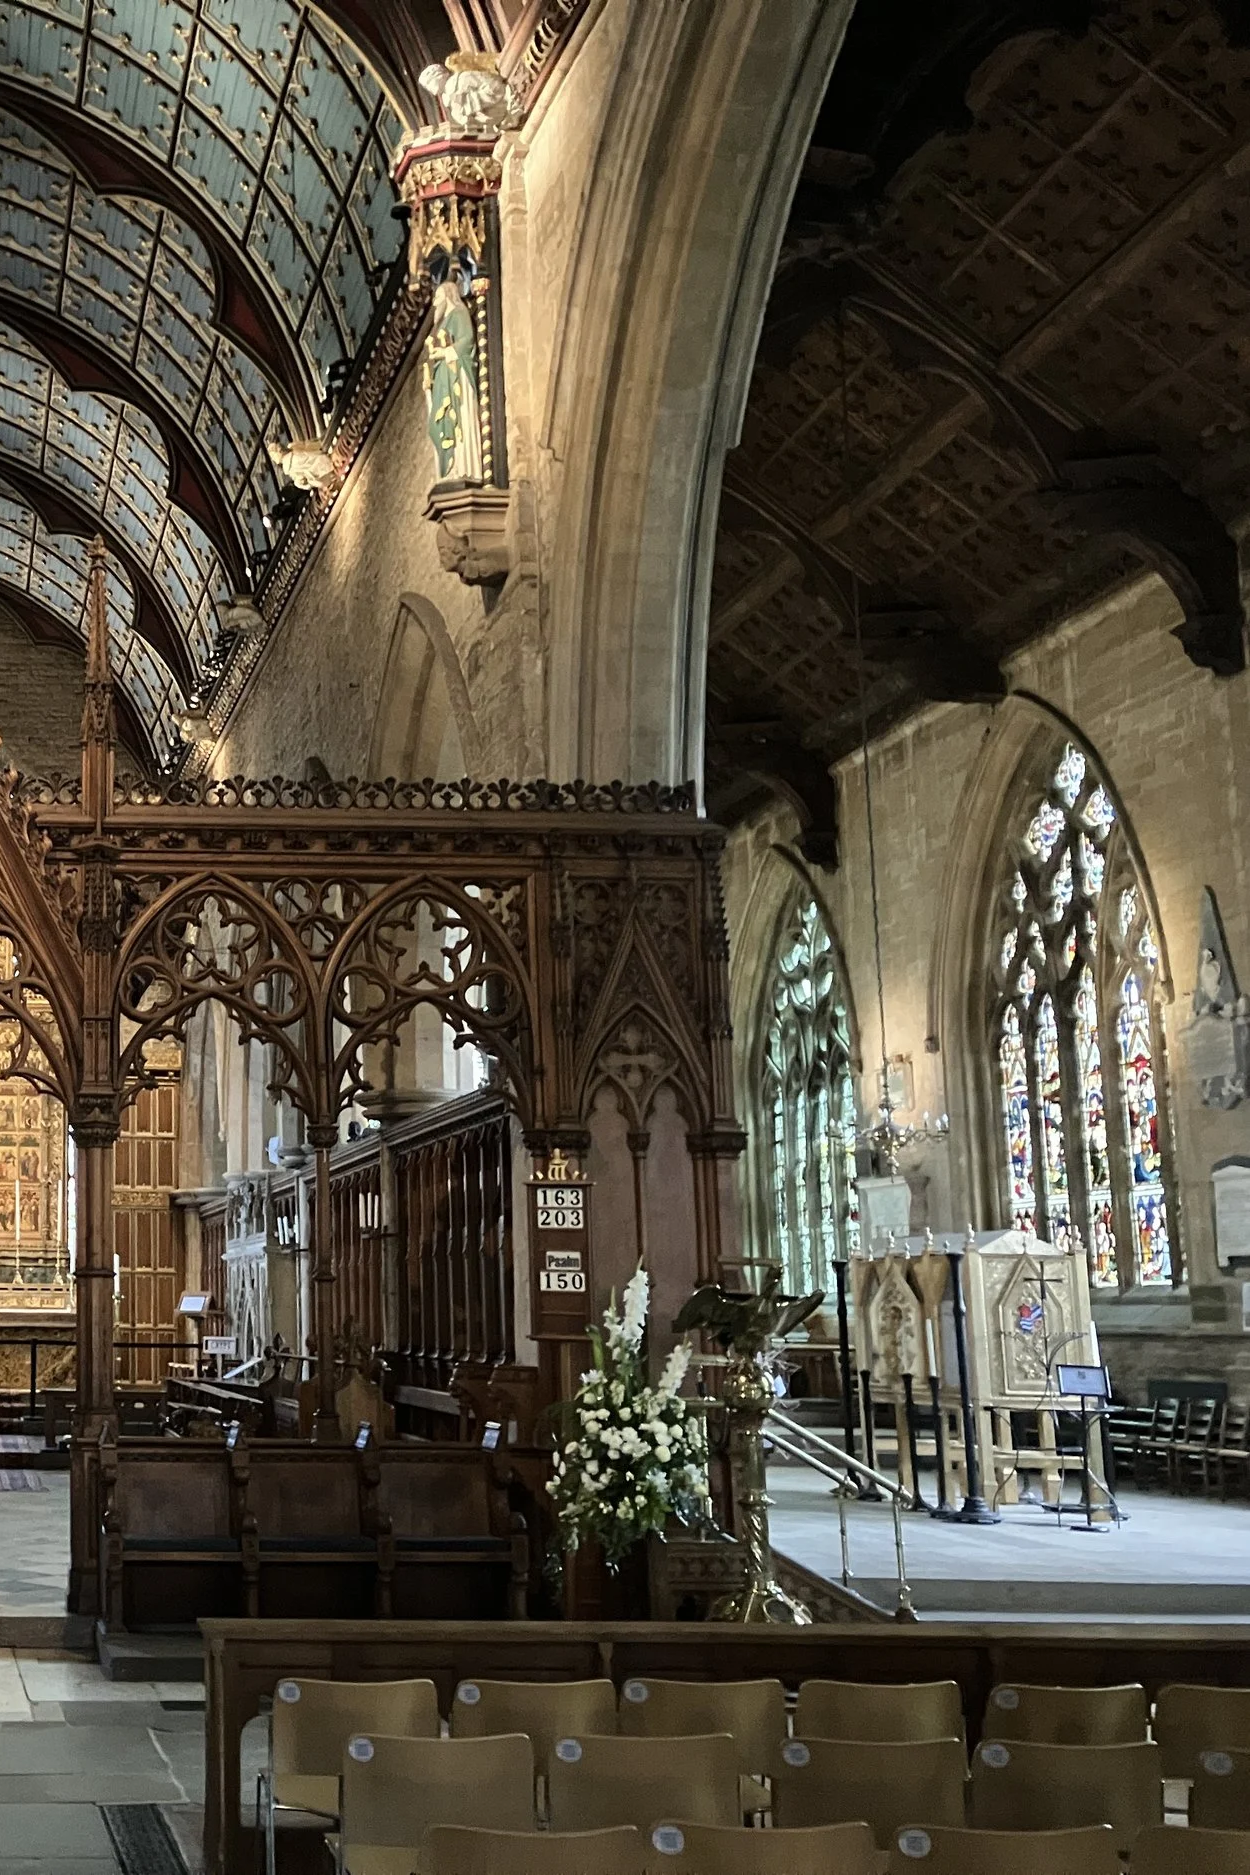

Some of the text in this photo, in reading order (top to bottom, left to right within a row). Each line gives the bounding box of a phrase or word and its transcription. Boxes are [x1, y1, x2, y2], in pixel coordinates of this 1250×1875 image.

[541, 1189, 581, 1206] 163
[540, 1210, 581, 1226] 203
[547, 1255, 580, 1268] Psalm
[545, 1273, 583, 1289] 150
